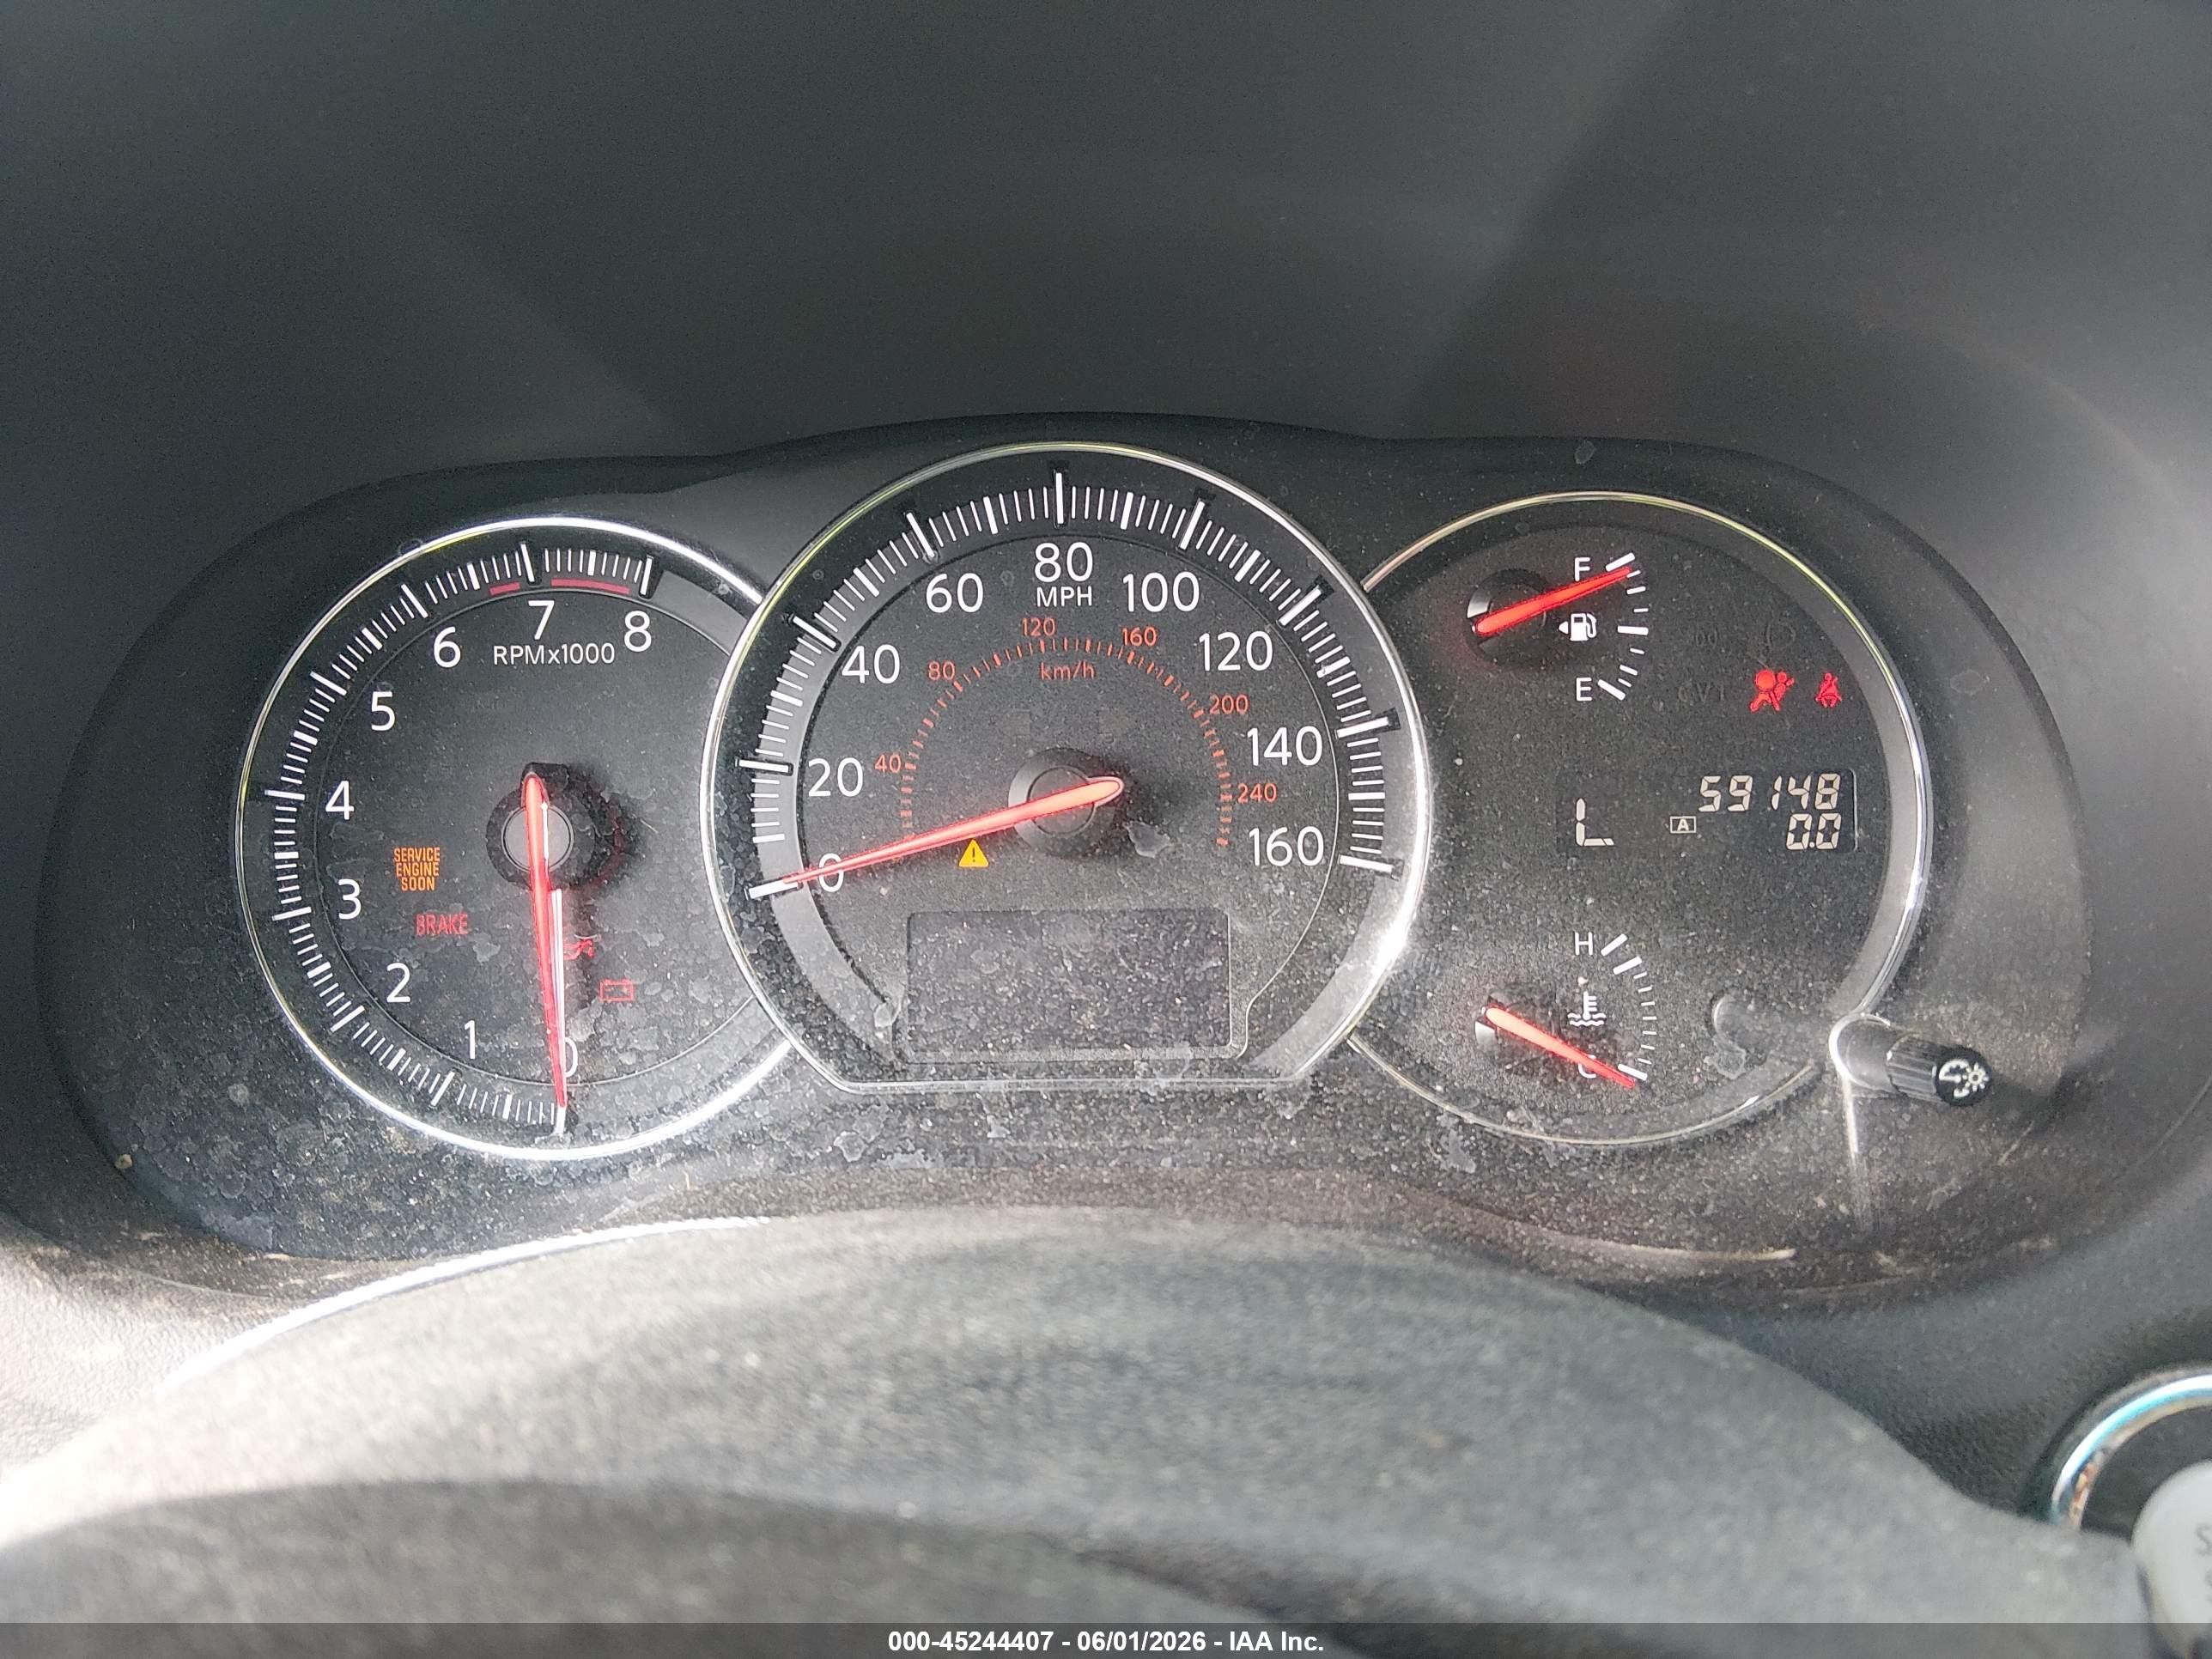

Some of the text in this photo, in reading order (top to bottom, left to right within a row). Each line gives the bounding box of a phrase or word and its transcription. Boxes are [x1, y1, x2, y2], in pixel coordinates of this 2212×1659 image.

[1034, 542, 1094, 583] 80
[1574, 556, 1591, 581] F
[926, 573, 984, 613] 60
[1036, 586, 1093, 607] MPH
[1122, 571, 1200, 612] 100
[528, 599, 555, 640] 7
[623, 610, 653, 653] 8
[1022, 617, 1057, 637] 120
[1121, 626, 1158, 647] 160
[433, 626, 462, 668] 6
[493, 643, 615, 666] RPMx1000
[842, 644, 901, 684] 40
[1199, 630, 1274, 672] 120
[927, 661, 957, 681] 80
[1039, 661, 1096, 681] km/h
[1576, 677, 1593, 702] E
[370, 690, 397, 732] 5
[1209, 695, 1250, 715] 200
[874, 754, 902, 774] 40
[1247, 726, 1323, 767] 140
[808, 757, 864, 798] 20
[1237, 782, 1279, 805] 240
[1698, 773, 1842, 812] 59148
[325, 780, 356, 821] 4
[1249, 825, 1325, 867] 160
[1785, 811, 1842, 850] 0.0
[393, 847, 441, 861] SERVICE
[395, 861, 441, 877] ENGINE
[818, 853, 844, 893] 0
[337, 878, 362, 920] 3
[400, 876, 437, 891] SOON
[415, 912, 469, 936] BRAKE
[1573, 931, 1594, 957] H
[386, 961, 412, 1003] 2
[464, 1019, 477, 1060] 1
